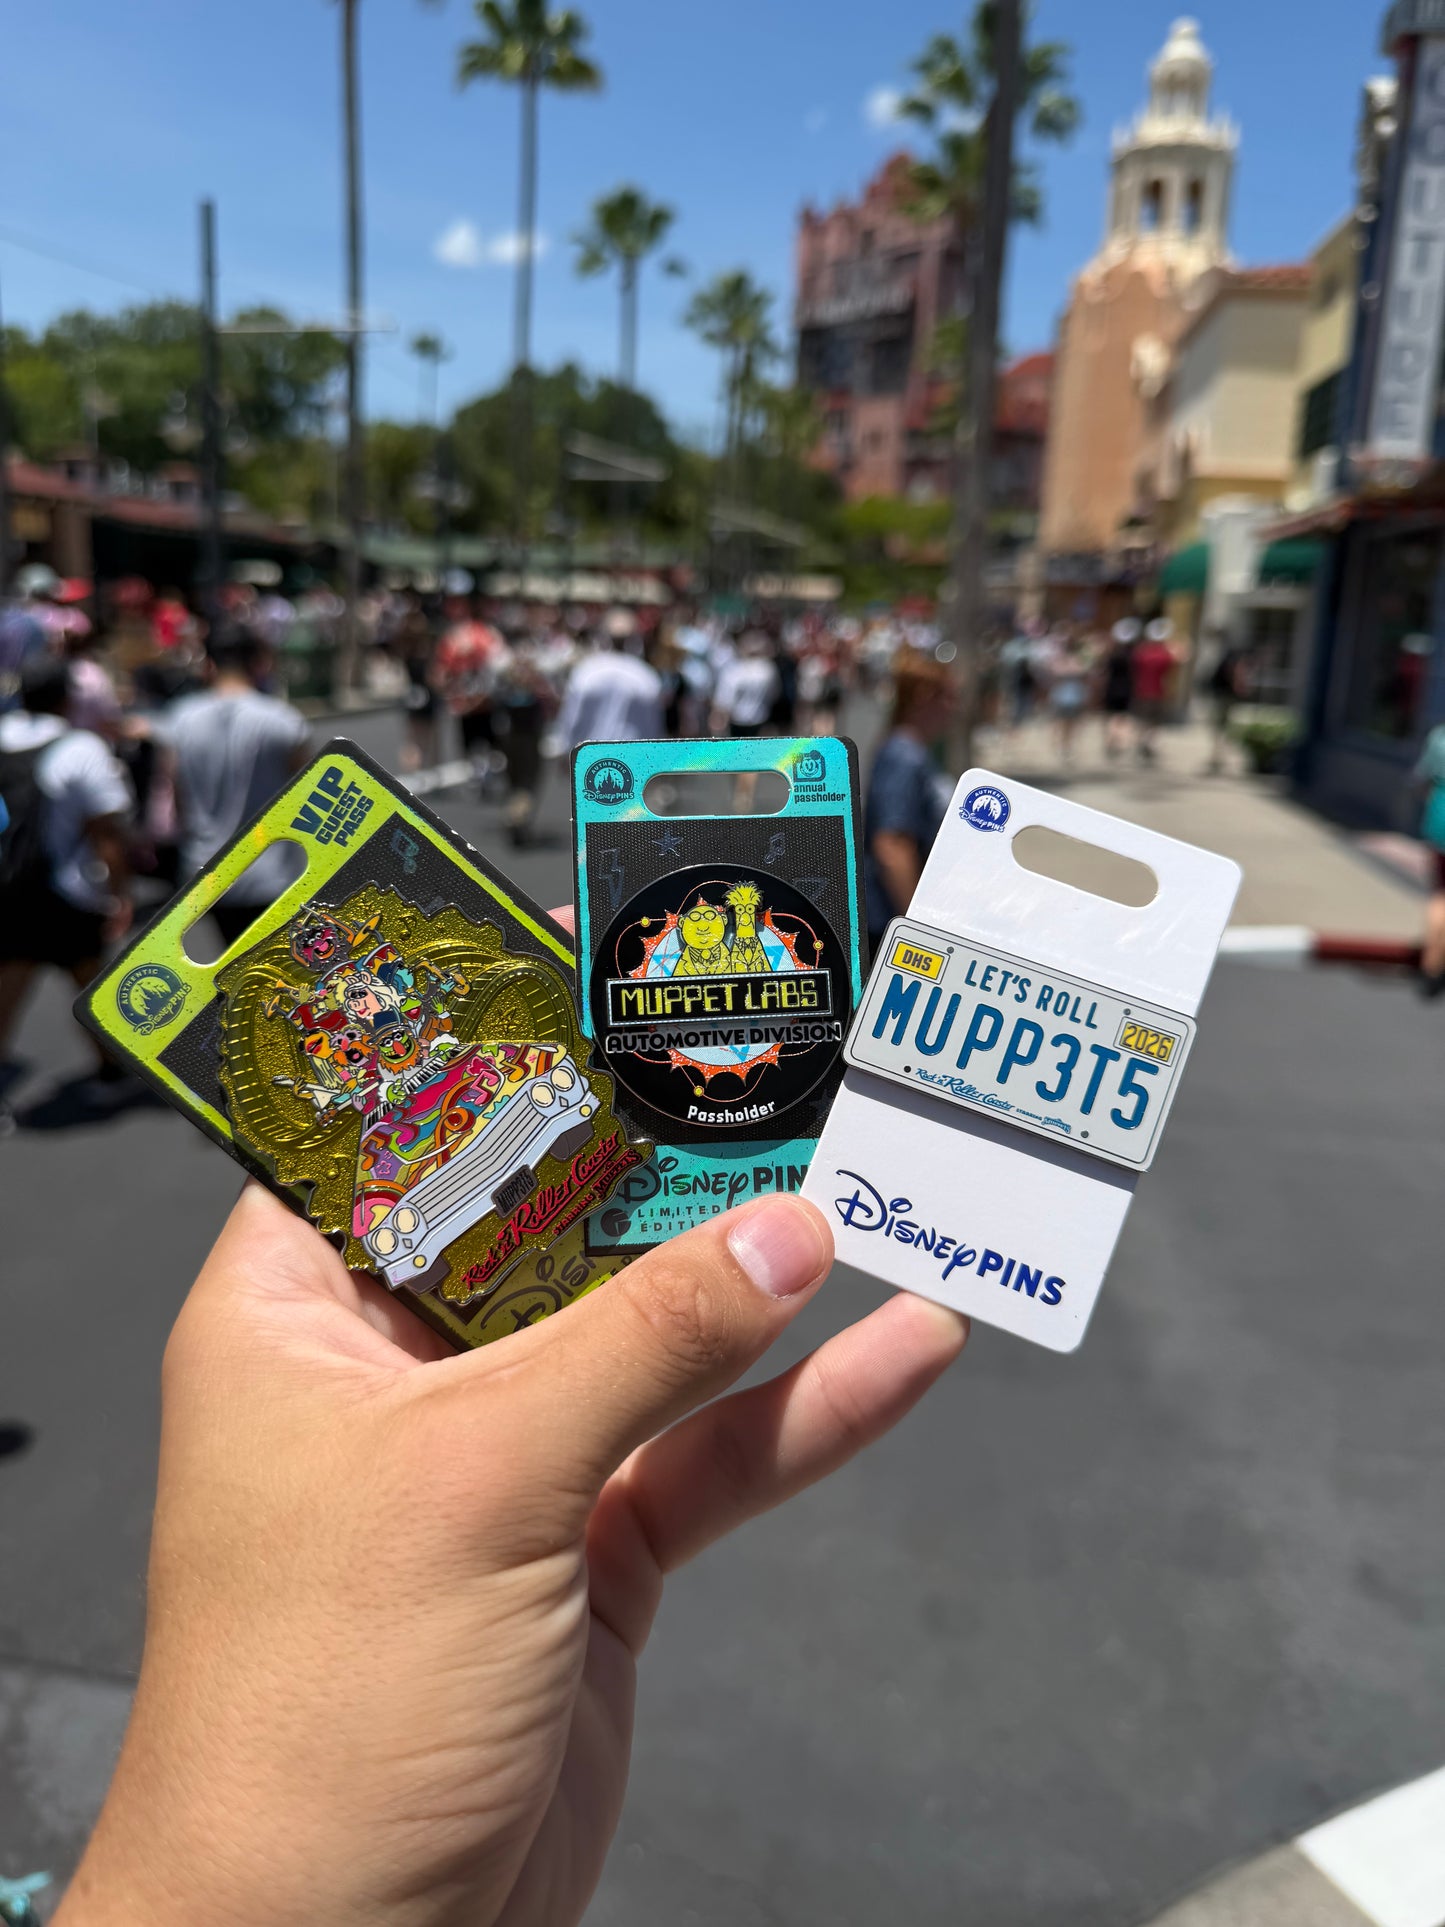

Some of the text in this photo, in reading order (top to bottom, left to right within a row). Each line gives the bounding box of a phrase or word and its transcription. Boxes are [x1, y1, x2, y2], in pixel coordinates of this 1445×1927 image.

[591, 761, 628, 774] AUTHENTIC
[290, 766, 344, 835] VIP
[793, 783, 826, 793] annual
[794, 792, 846, 804] passholder
[975, 789, 1007, 808] AUTHENTIC
[315, 781, 363, 845] GUEST
[333, 795, 375, 848] PASS
[902, 949, 932, 971] DHS
[121, 968, 159, 1005] AUTHENTIC
[621, 978, 818, 1017] MUPPET LABS
[965, 960, 1098, 1029] LET'S ROLL
[606, 1021, 842, 1053] AUTOMOTIVE DIVISION
[872, 974, 1159, 1130] MUPP3T5
[1122, 1025, 1172, 1060] 2026
[942, 1074, 985, 1101] Roller
[982, 1092, 1015, 1111] Coaster
[687, 1101, 775, 1124] Passholder
[753, 1164, 808, 1194] PIN
[460, 1248, 498, 1291] Rock
[496, 1174, 575, 1246] Roller
[571, 1130, 619, 1188] Coaster
[552, 1193, 595, 1237] STARRING
[637, 1205, 720, 1218] LIMITED
[640, 1220, 706, 1233] ÉDITI
[976, 1247, 1067, 1306] PINS
